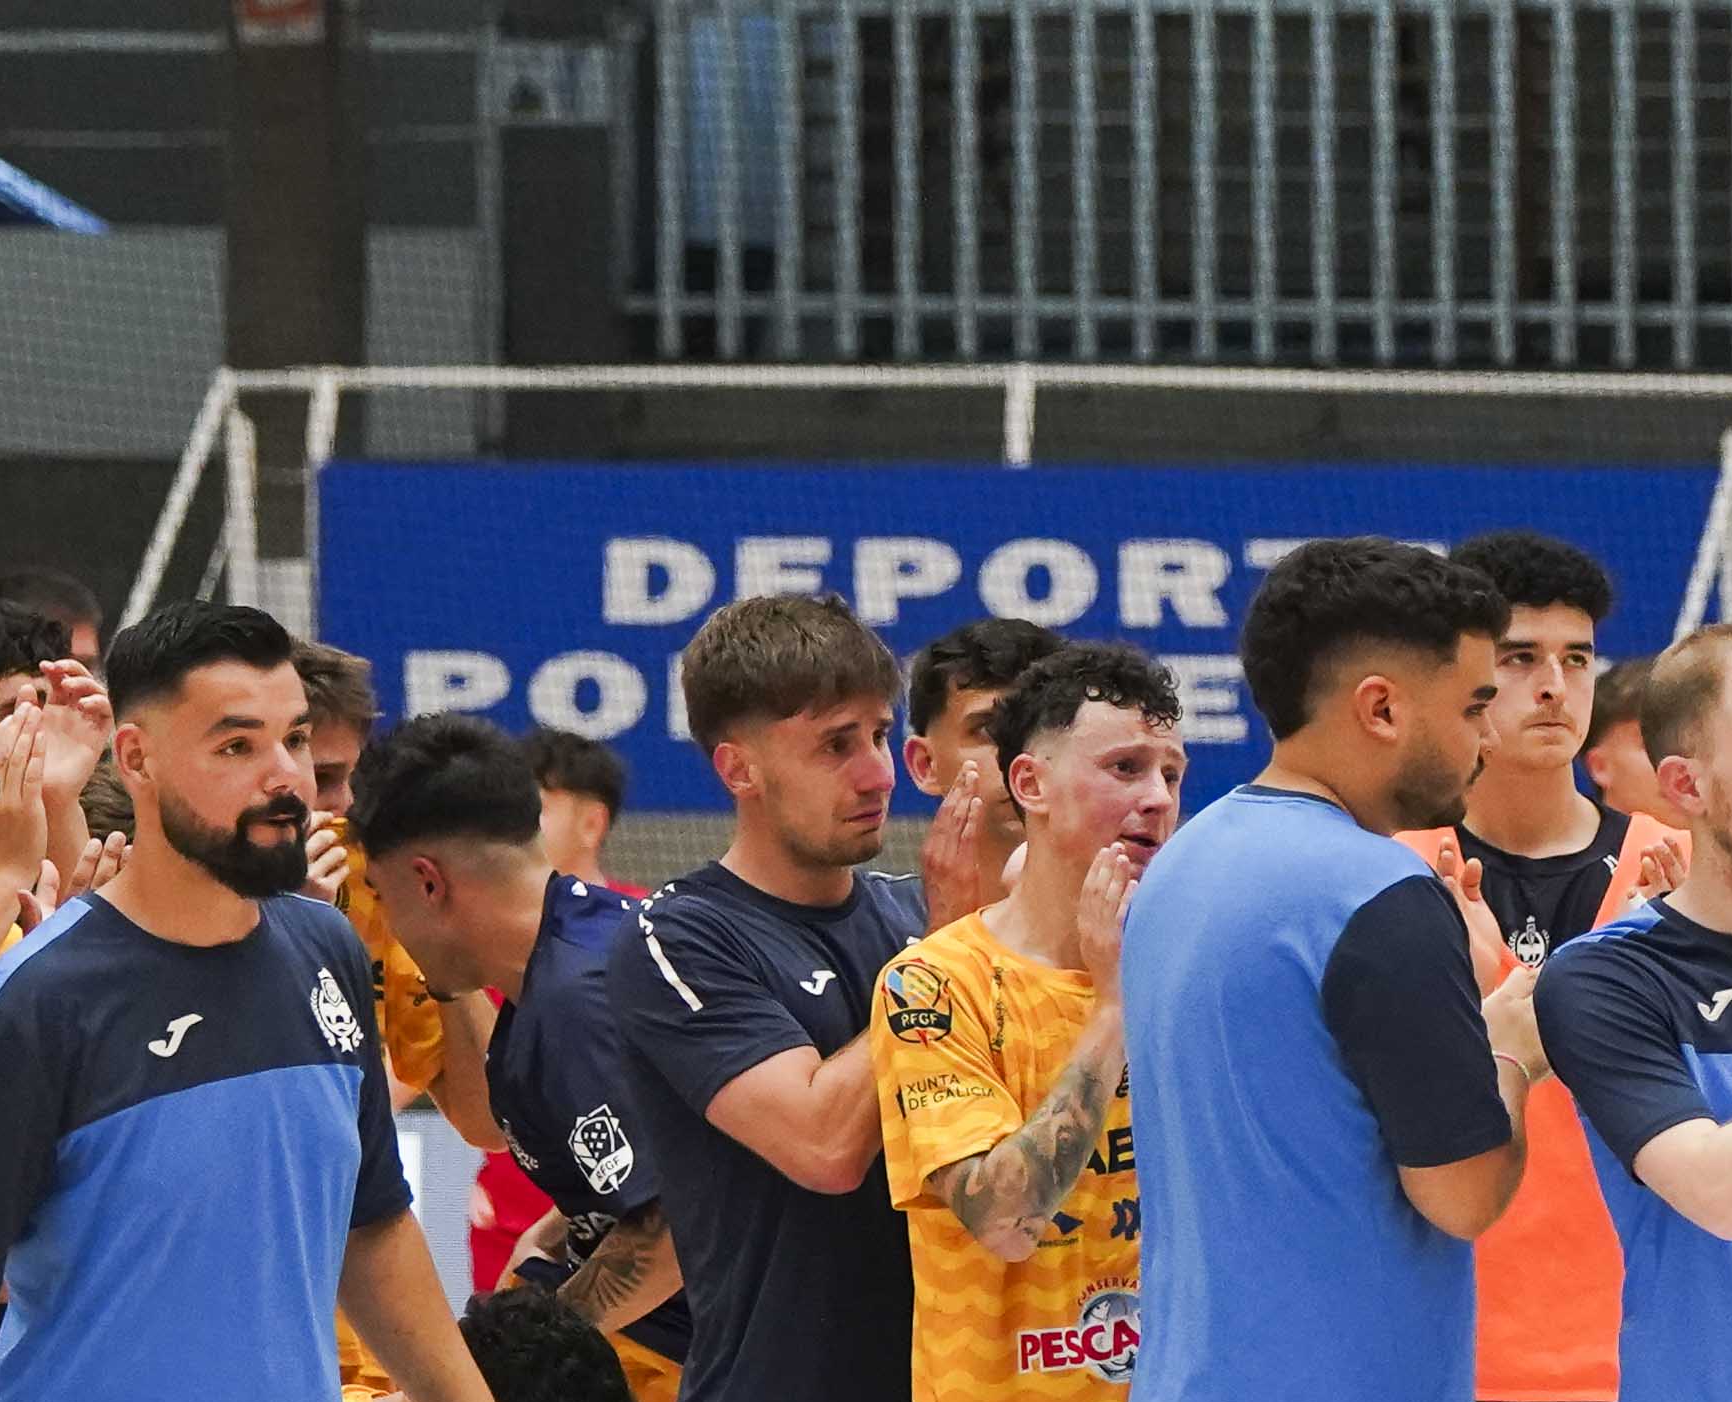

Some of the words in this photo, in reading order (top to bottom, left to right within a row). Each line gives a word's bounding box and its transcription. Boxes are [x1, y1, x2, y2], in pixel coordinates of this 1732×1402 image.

[900, 1012, 938, 1028] RFGF
[907, 1073, 960, 1095] XUNTA
[909, 1095, 928, 1111] DE
[1021, 1318, 1140, 1370] PESCA
